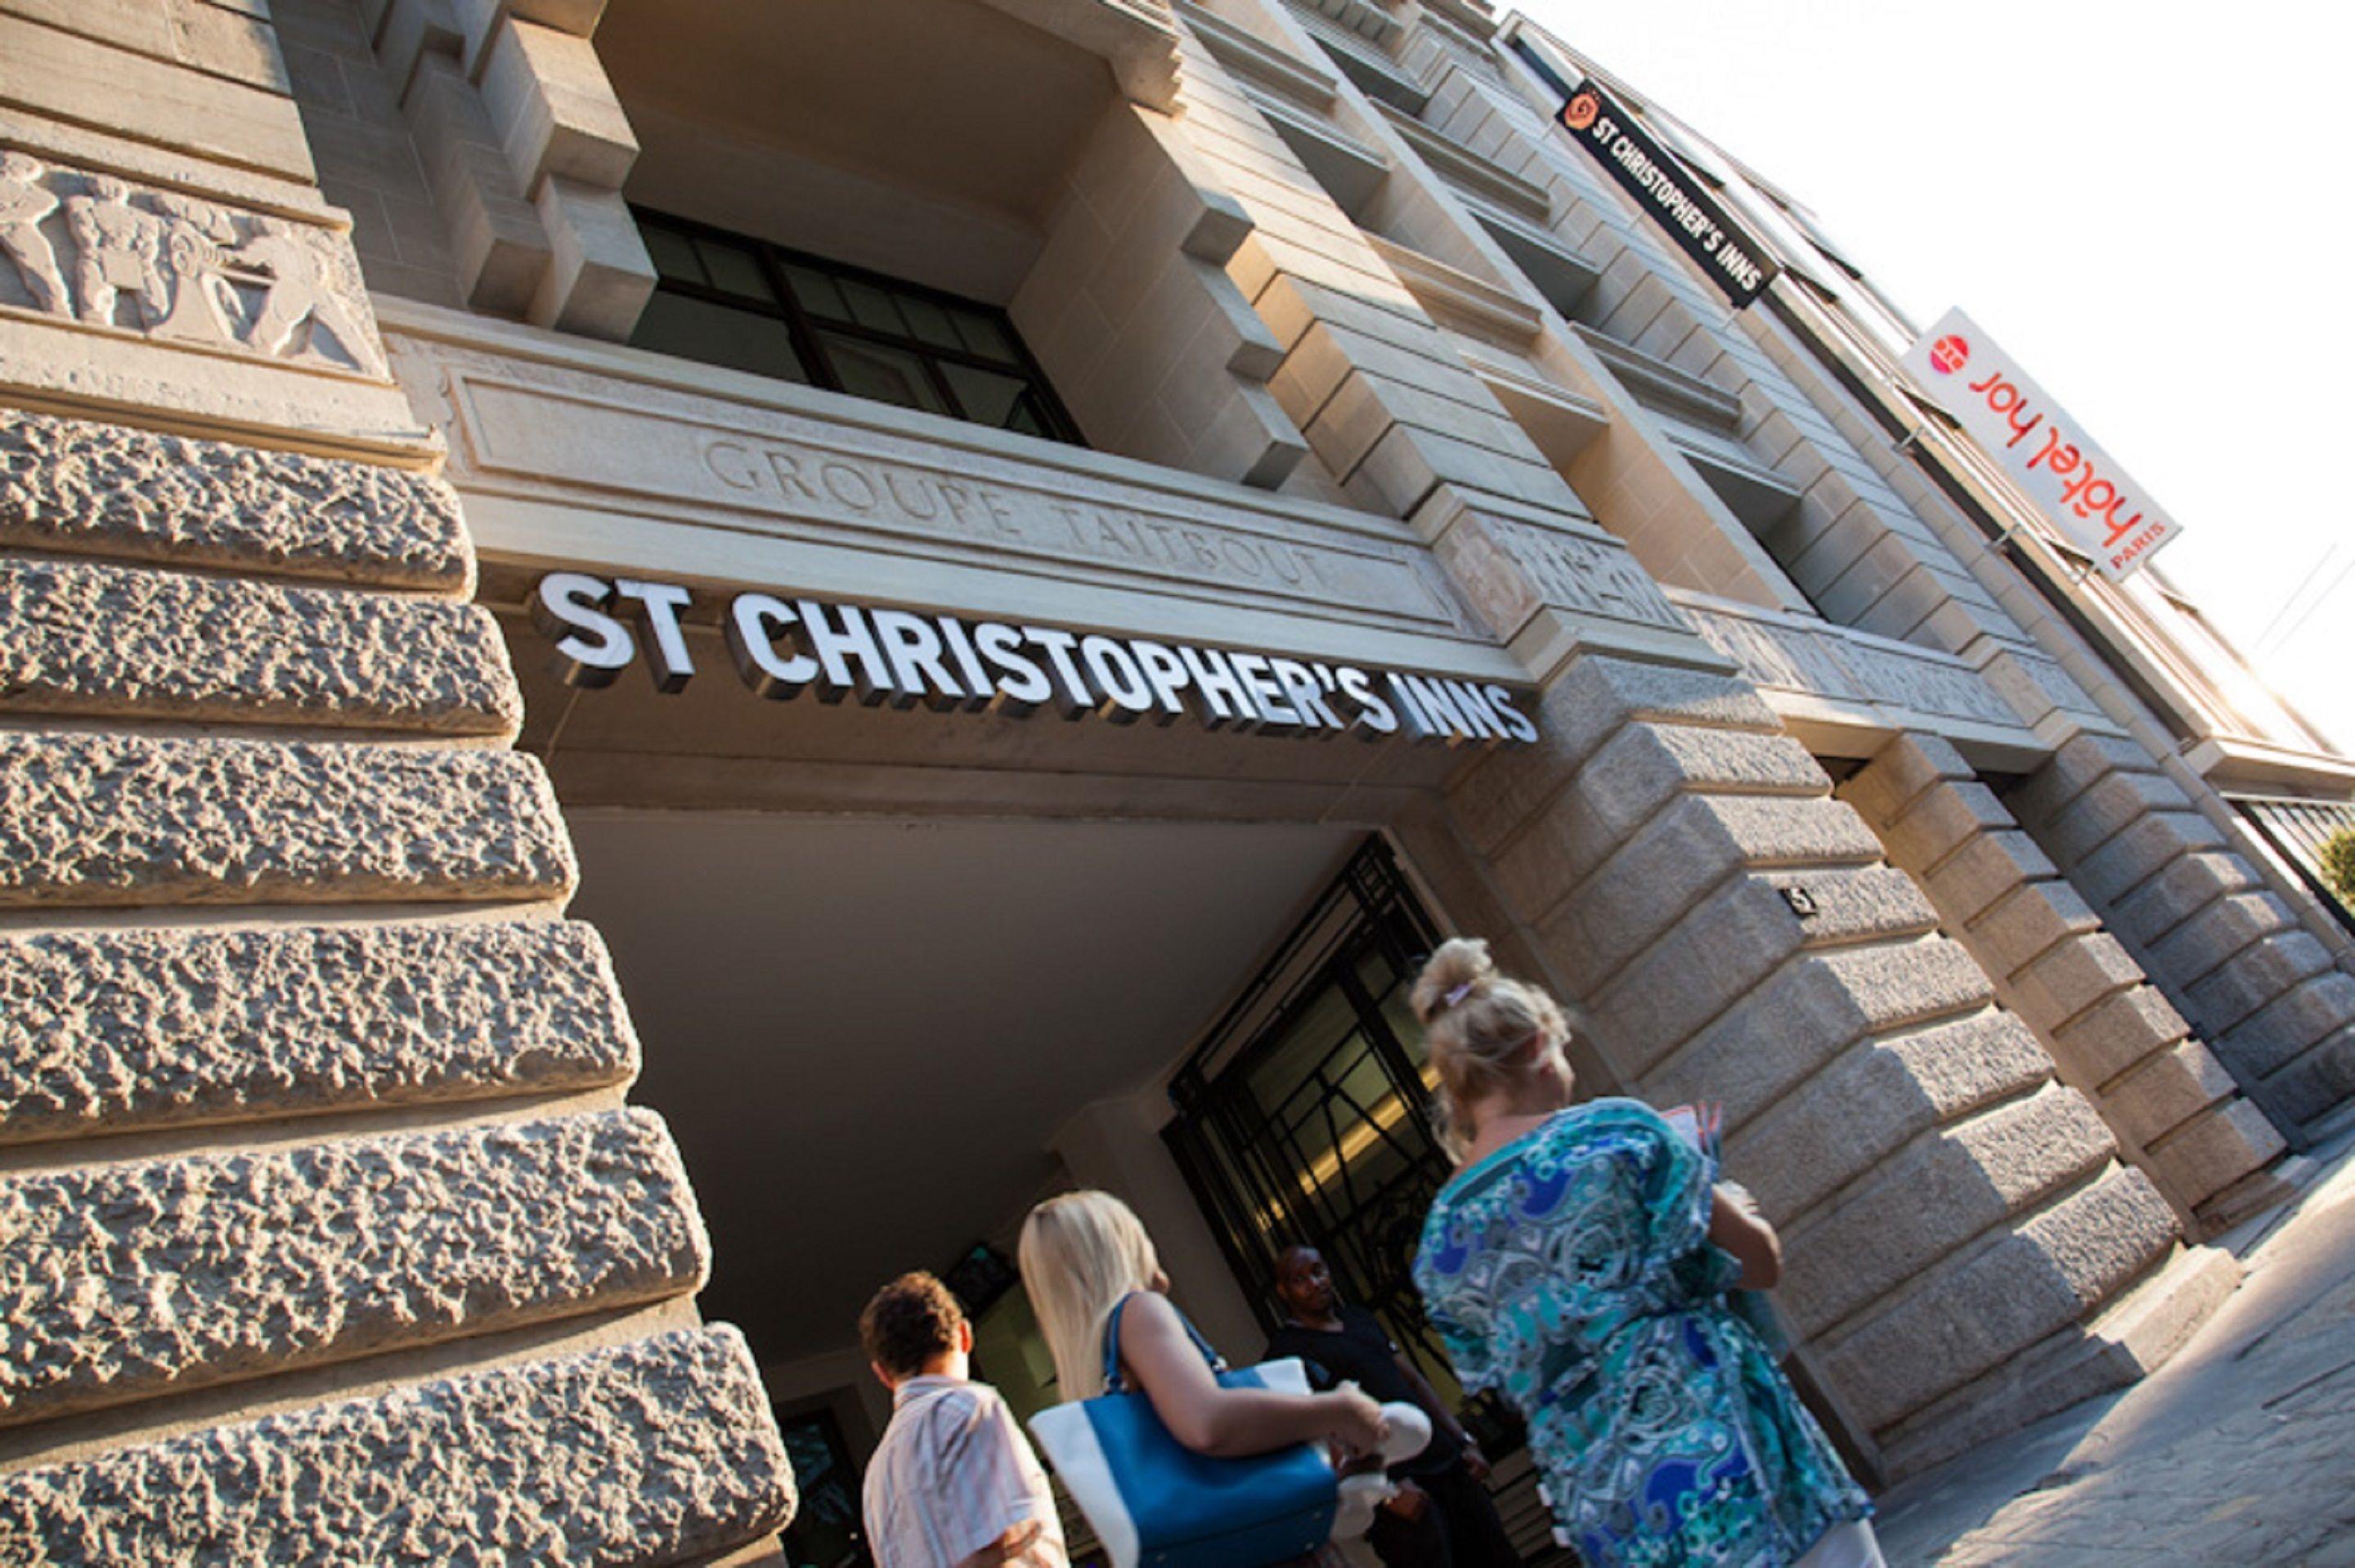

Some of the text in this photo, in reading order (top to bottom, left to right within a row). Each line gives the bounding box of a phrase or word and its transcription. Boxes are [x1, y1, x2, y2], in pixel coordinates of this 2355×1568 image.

[1592, 117, 1761, 291] ST CHRISTOPHER'S INNS
[704, 440, 1328, 590] GROUPE TAITBOUT
[2026, 426, 2143, 548] hôtel
[2110, 521, 2165, 569] PARIS
[537, 571, 1539, 743] ST CHRISTOPHER'S INNS
